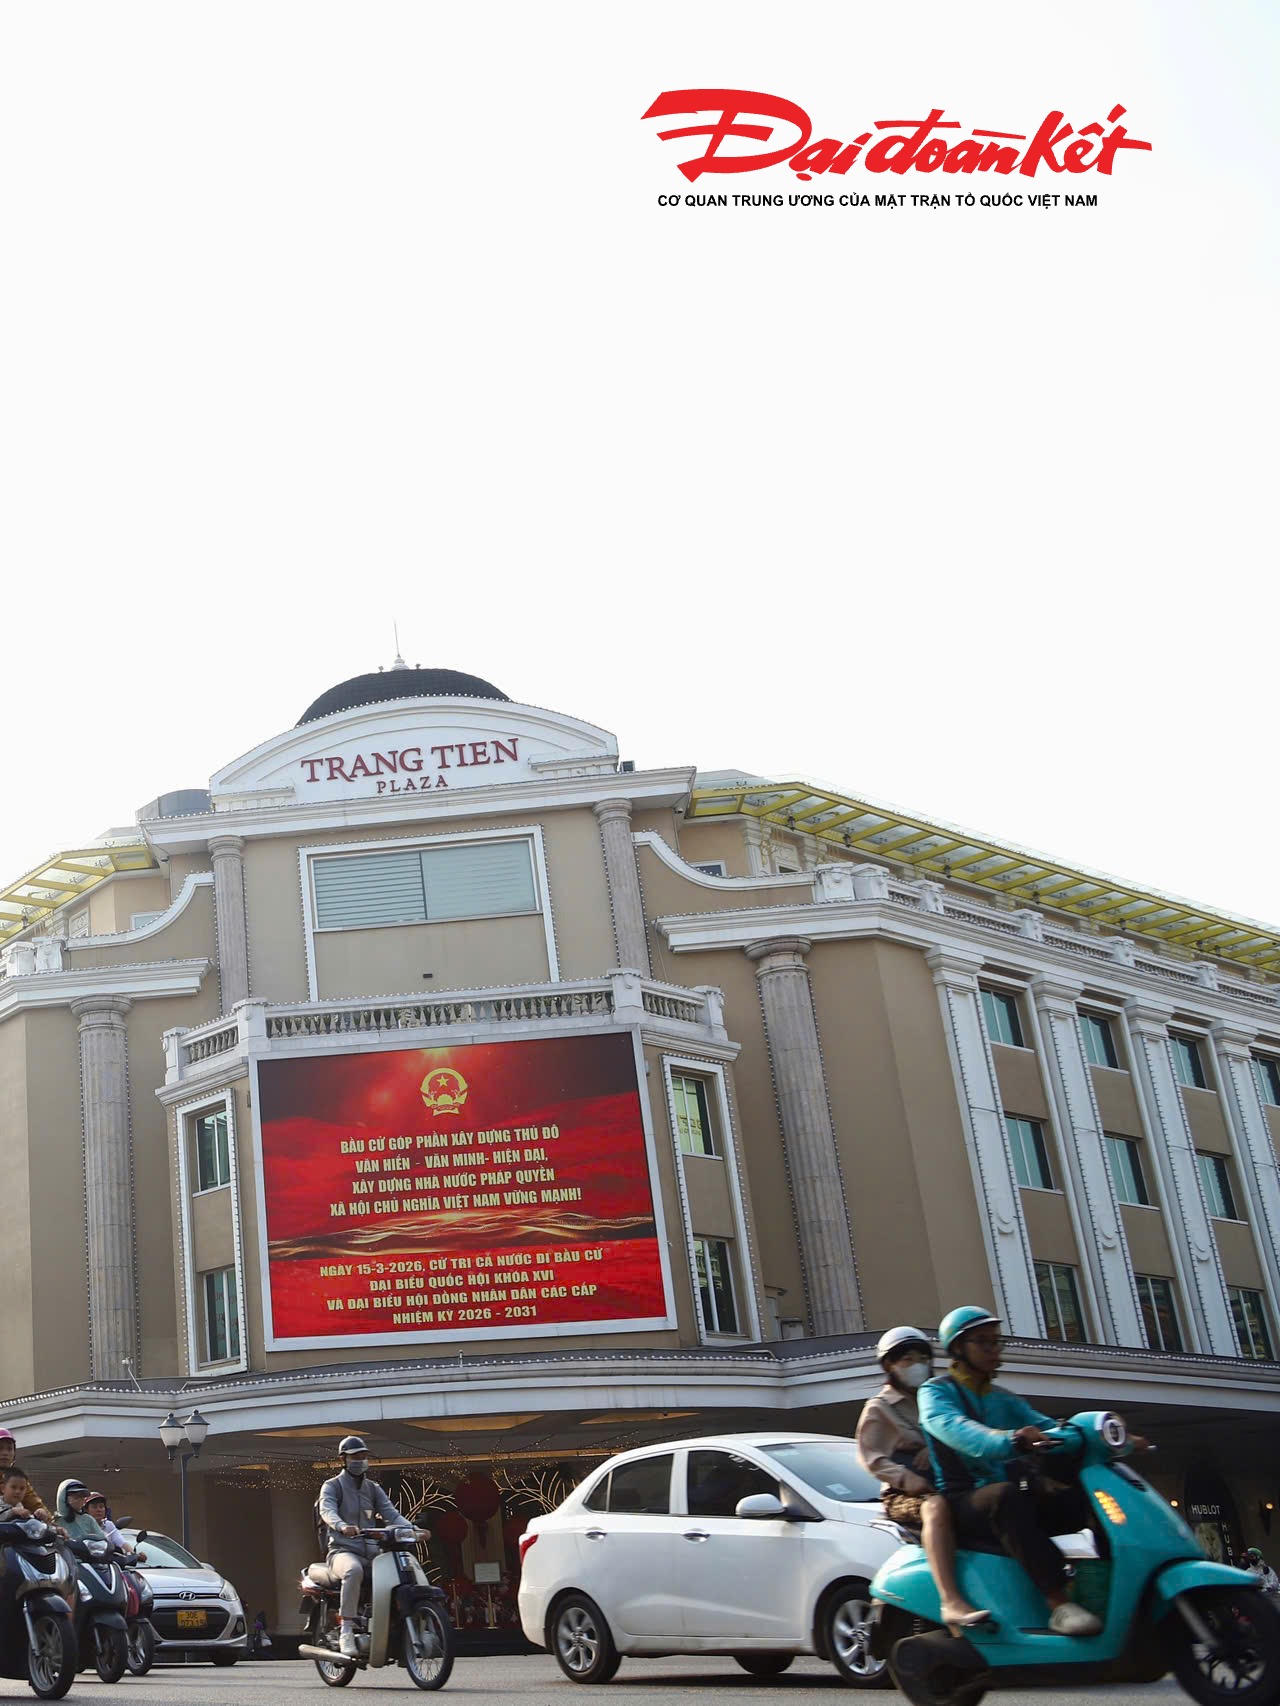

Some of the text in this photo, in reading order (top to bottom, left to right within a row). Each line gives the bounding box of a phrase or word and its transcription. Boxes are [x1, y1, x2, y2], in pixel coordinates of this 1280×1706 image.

[301, 738, 519, 782] TRANG TIEN
[376, 775, 448, 793] PLAZA
[341, 1139, 364, 1154] BẦU
[416, 1134, 448, 1148] PHẦN
[451, 1131, 473, 1146] XÂY
[478, 1129, 511, 1145] DỰNG
[542, 1124, 559, 1139] ĐÔ
[383, 1154, 410, 1171] HIẾN
[493, 1149, 520, 1165] HIỆN
[352, 1166, 555, 1194] XÂY DỰNG NHÀ NƯỚC PHÁP QUYỀN
[349, 1200, 370, 1216] HỘI
[443, 1194, 470, 1210] VIỆT
[473, 1193, 500, 1207] NAM
[541, 1188, 582, 1204] MẠNH!
[320, 1264, 353, 1276] NGÀY
[450, 1258, 472, 1269] TRI
[497, 1253, 532, 1266] NƯỚC
[554, 1249, 581, 1262] BẦU
[370, 1280, 392, 1292] ĐẠI
[468, 1272, 490, 1286] HỘI
[533, 1270, 554, 1282] XVI
[327, 1298, 344, 1310] VÀ
[348, 1298, 369, 1310] ĐẠI
[406, 1293, 429, 1307] HỘI
[432, 1288, 468, 1305] ĐỒNG
[472, 1288, 507, 1302] NHÂN
[511, 1287, 537, 1300] DÂN
[541, 1286, 568, 1299] CÁC
[572, 1283, 597, 1297] CẤP
[393, 1311, 434, 1325] NHIỆM
[458, 1308, 492, 1321] 2026
[505, 1305, 537, 1317] 2031
[1191, 1504, 1220, 1515] HUBLOT
